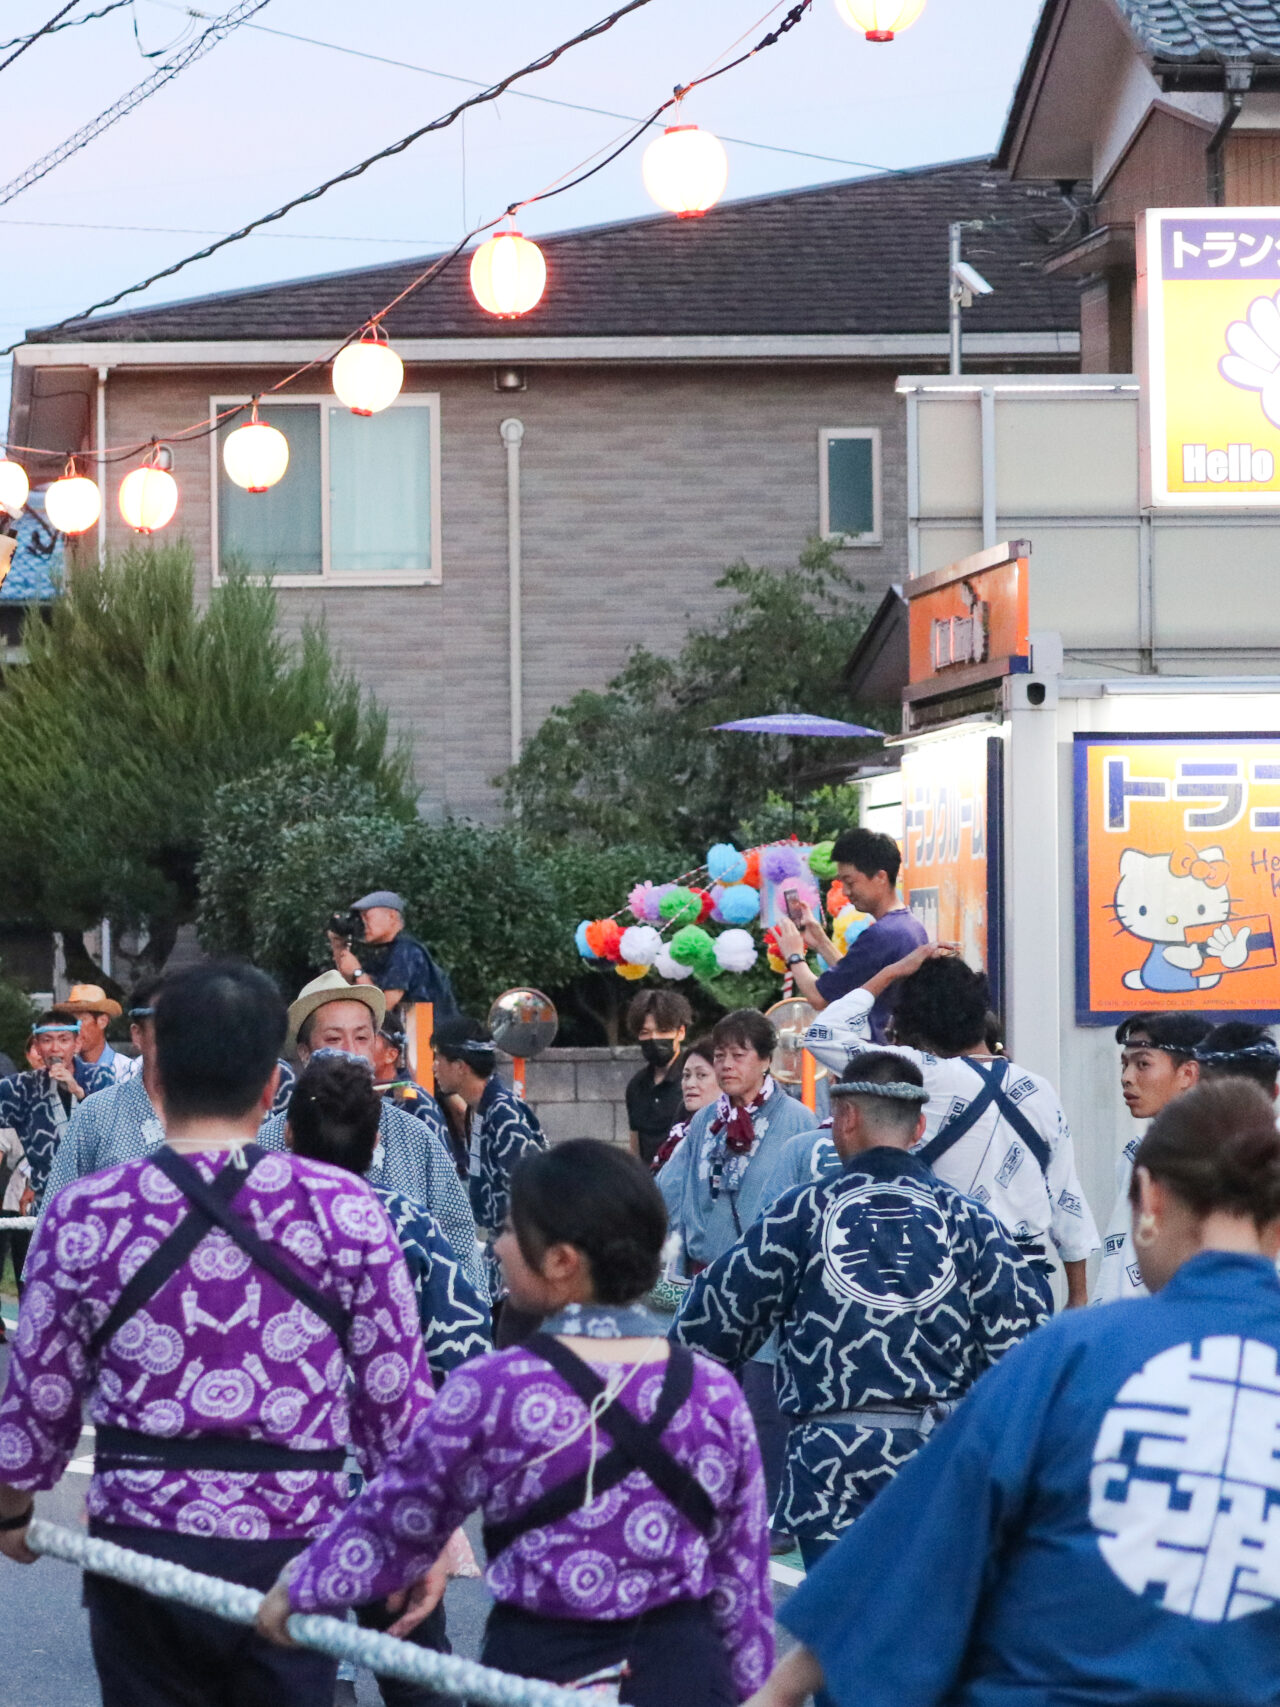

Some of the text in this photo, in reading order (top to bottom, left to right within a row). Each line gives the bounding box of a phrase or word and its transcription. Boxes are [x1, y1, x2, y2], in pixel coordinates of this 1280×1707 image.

[1174, 229, 1280, 269] トラン
[1182, 443, 1275, 484] Hello
